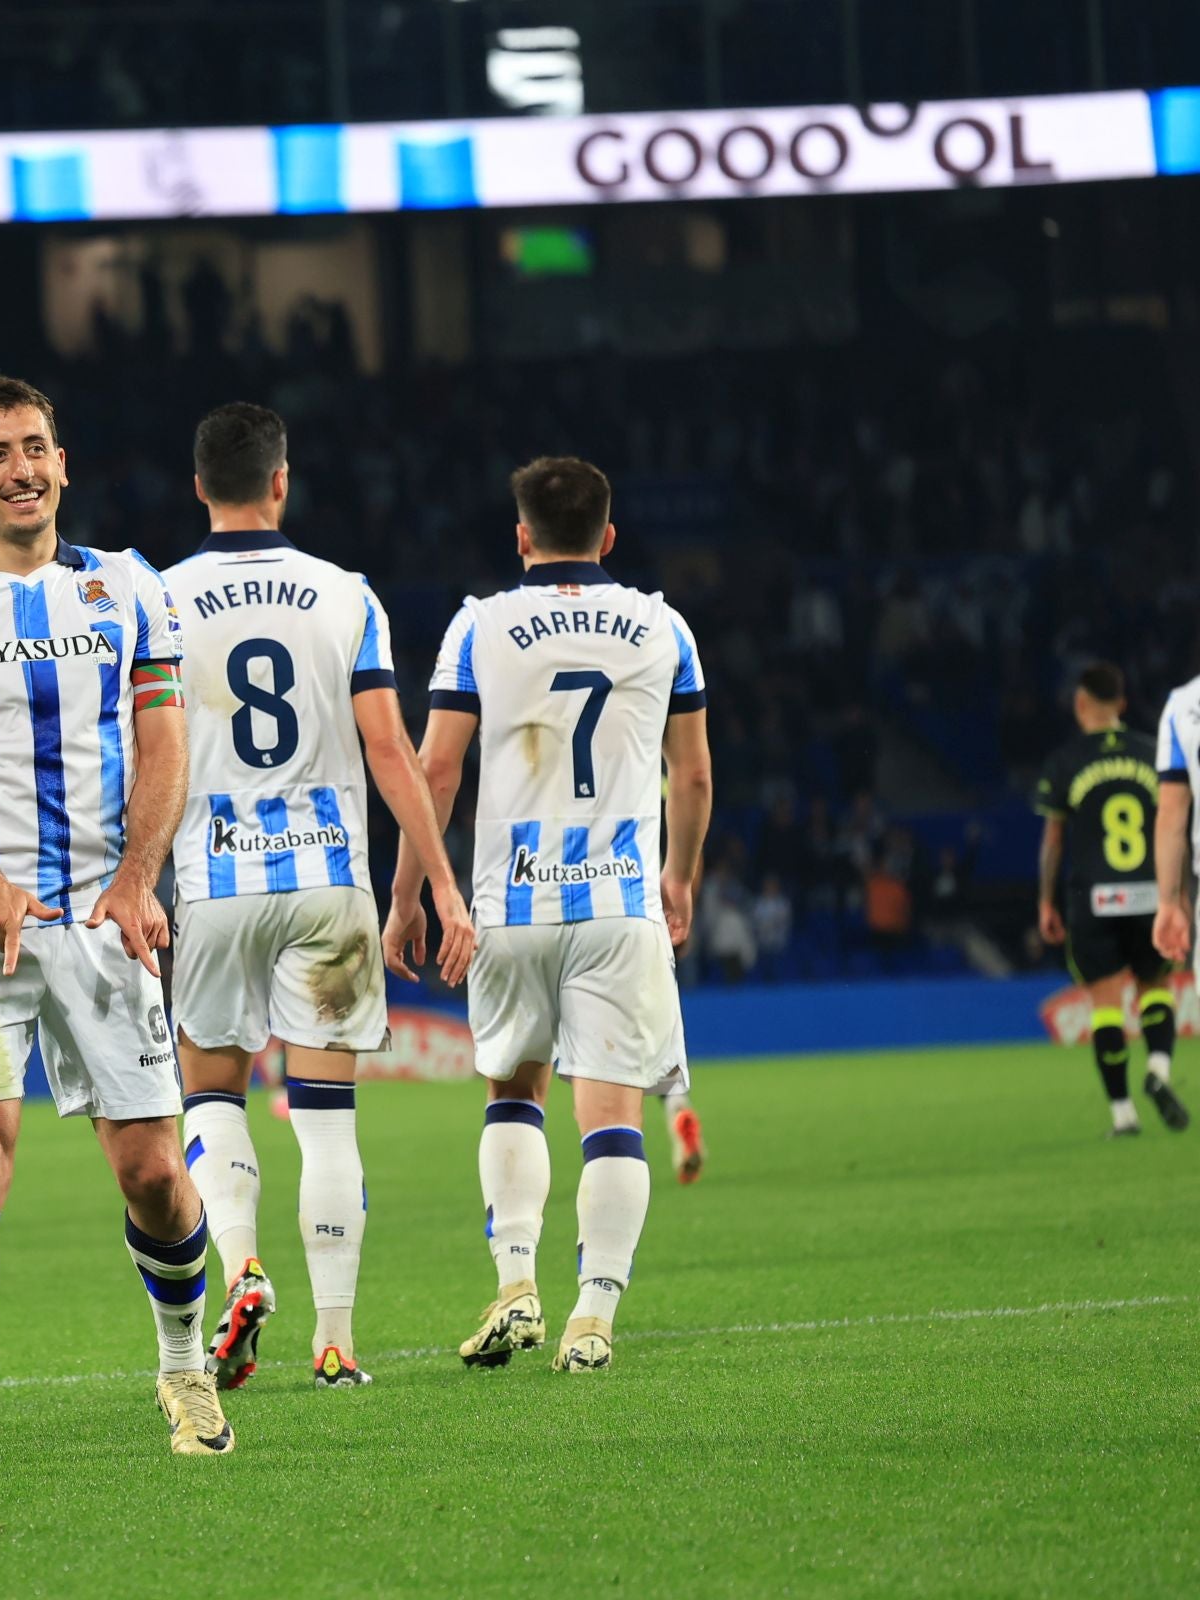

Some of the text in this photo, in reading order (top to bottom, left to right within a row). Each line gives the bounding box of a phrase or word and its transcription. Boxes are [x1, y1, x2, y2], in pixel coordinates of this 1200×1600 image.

[193, 580, 318, 620] MERINO
[508, 610, 650, 650] BARRENE
[226, 638, 299, 769] 8
[549, 670, 614, 799] 7
[212, 818, 345, 853] Kutxabank
[1102, 792, 1147, 872] 8
[513, 848, 639, 883] Kutxabank
[315, 1224, 345, 1237] RS
[510, 1245, 530, 1255] RS
